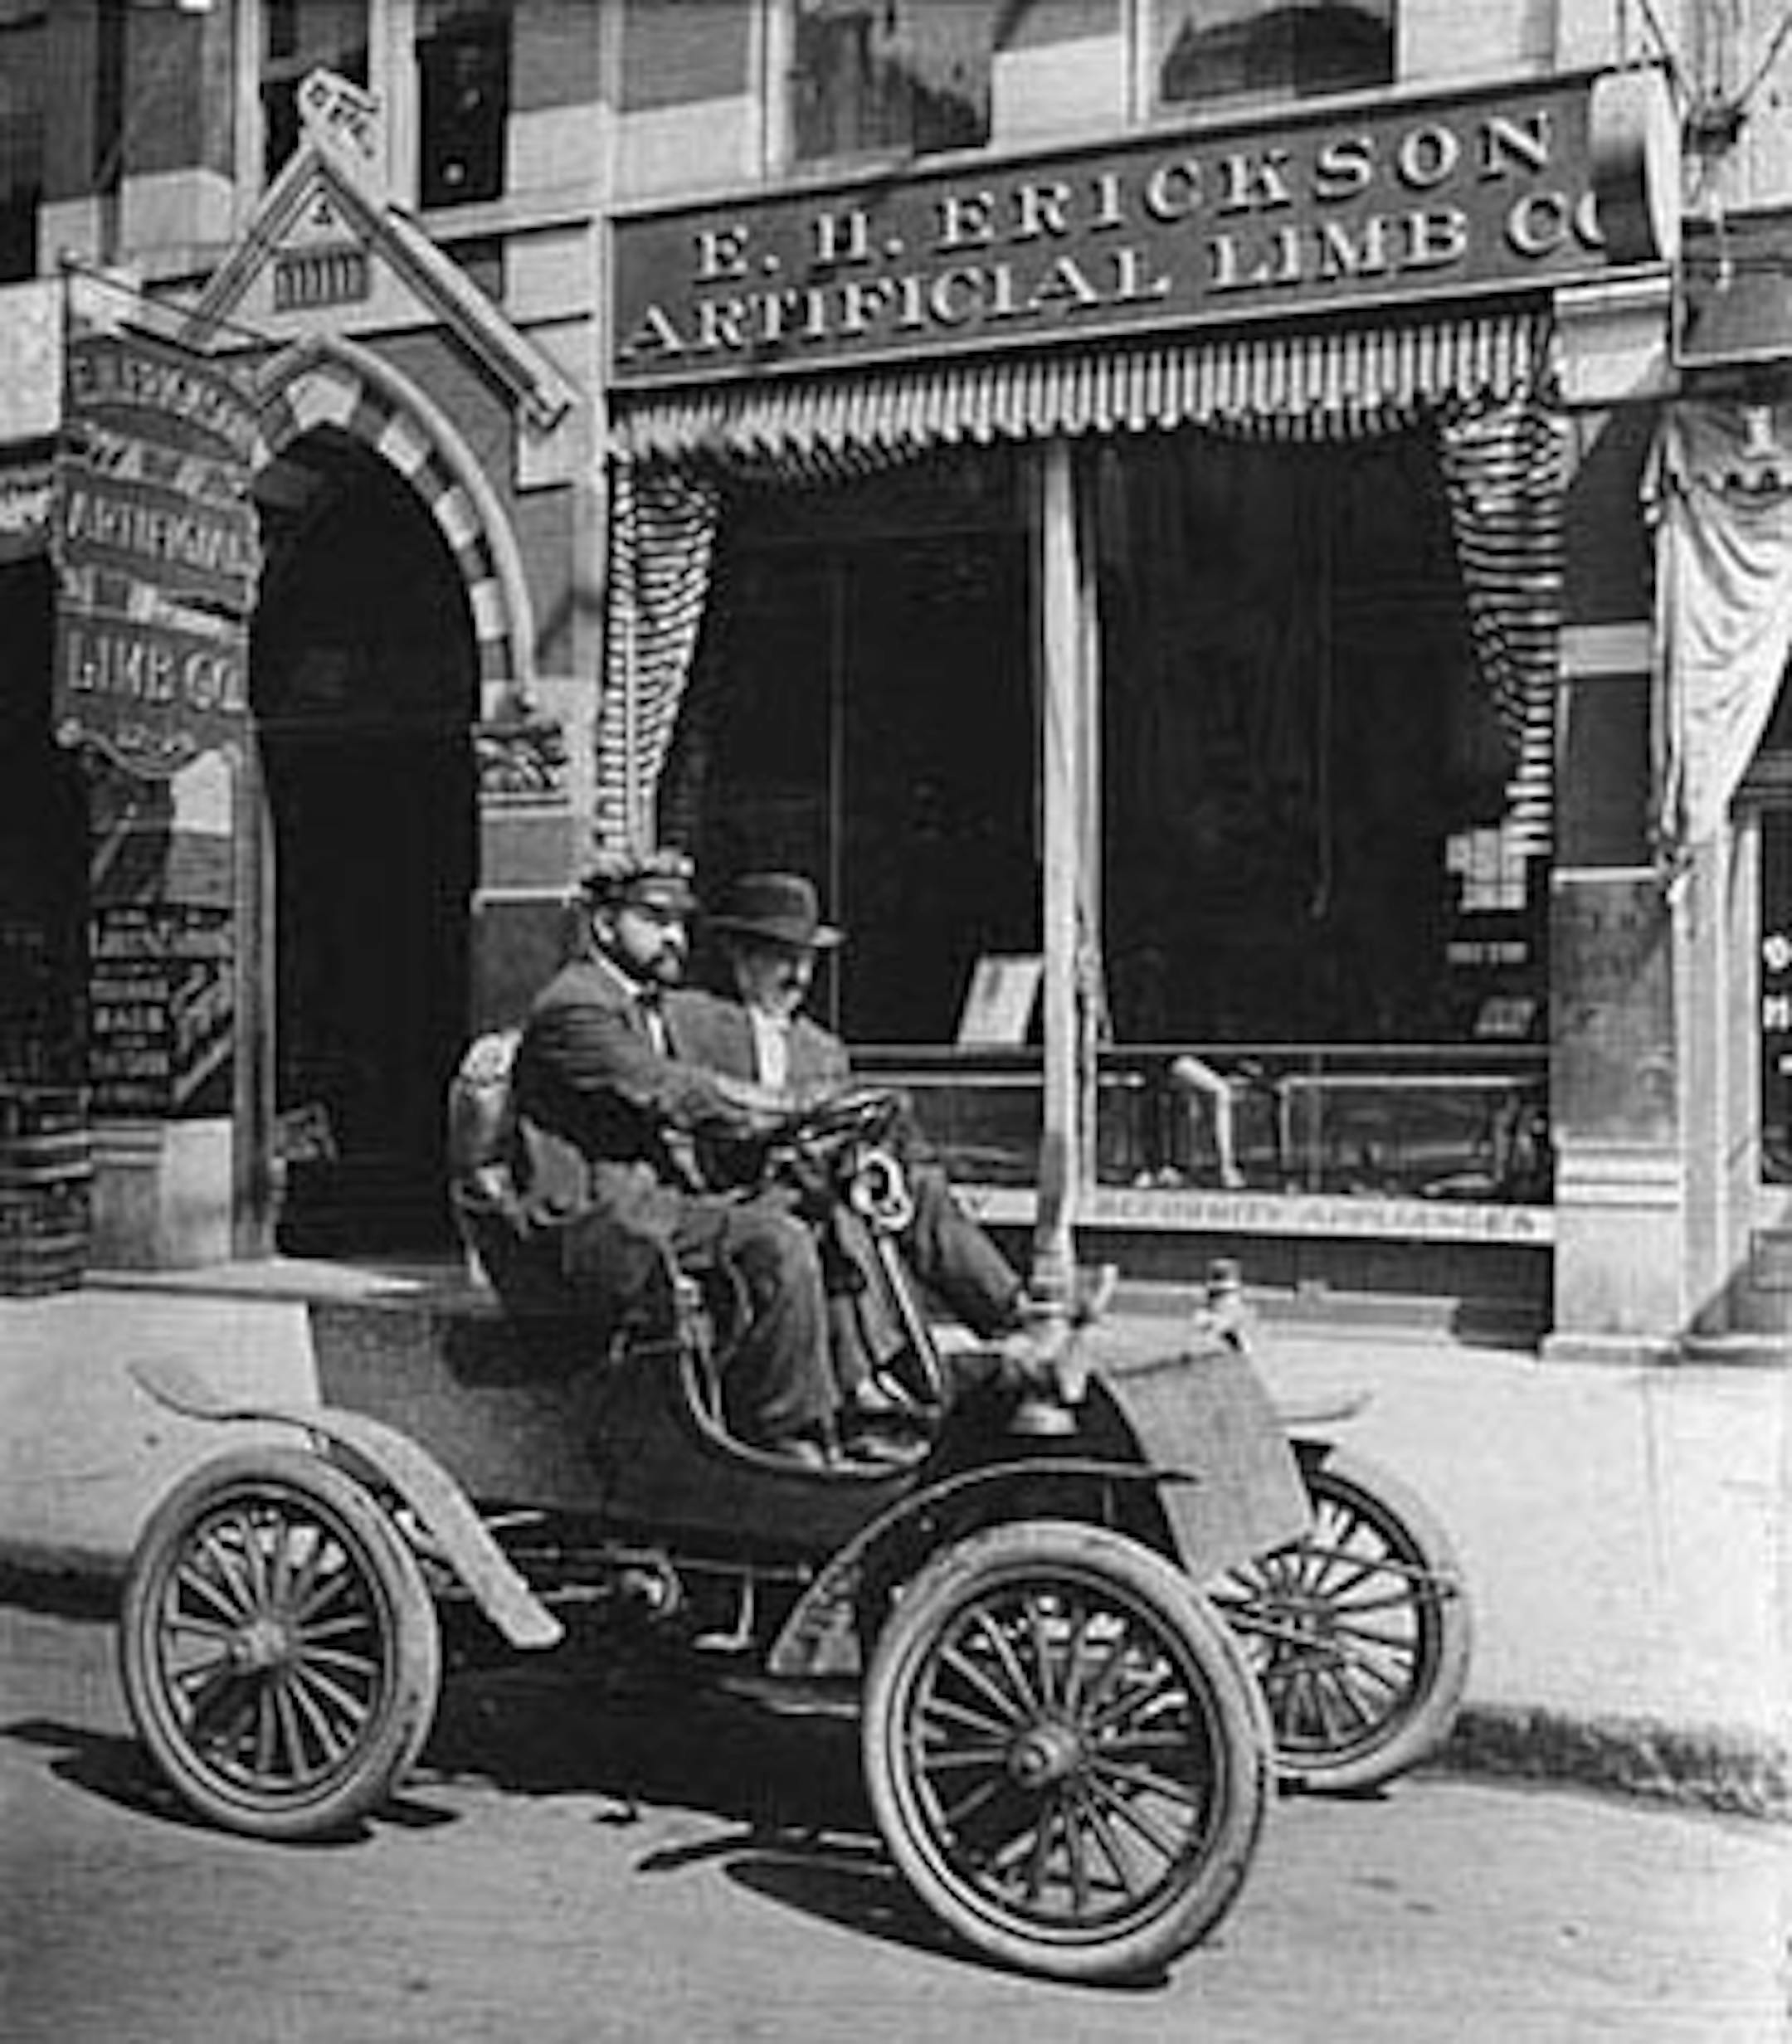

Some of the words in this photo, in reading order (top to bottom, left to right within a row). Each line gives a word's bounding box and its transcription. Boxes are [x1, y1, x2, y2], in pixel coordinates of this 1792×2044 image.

[700, 224, 781, 277] E.
[817, 209, 905, 260] H.
[942, 110, 1553, 244] ERICKSON
[619, 247, 1171, 358] ARTIFICIAL
[1208, 206, 1468, 290] LIMB
[68, 632, 174, 700] LIMB
